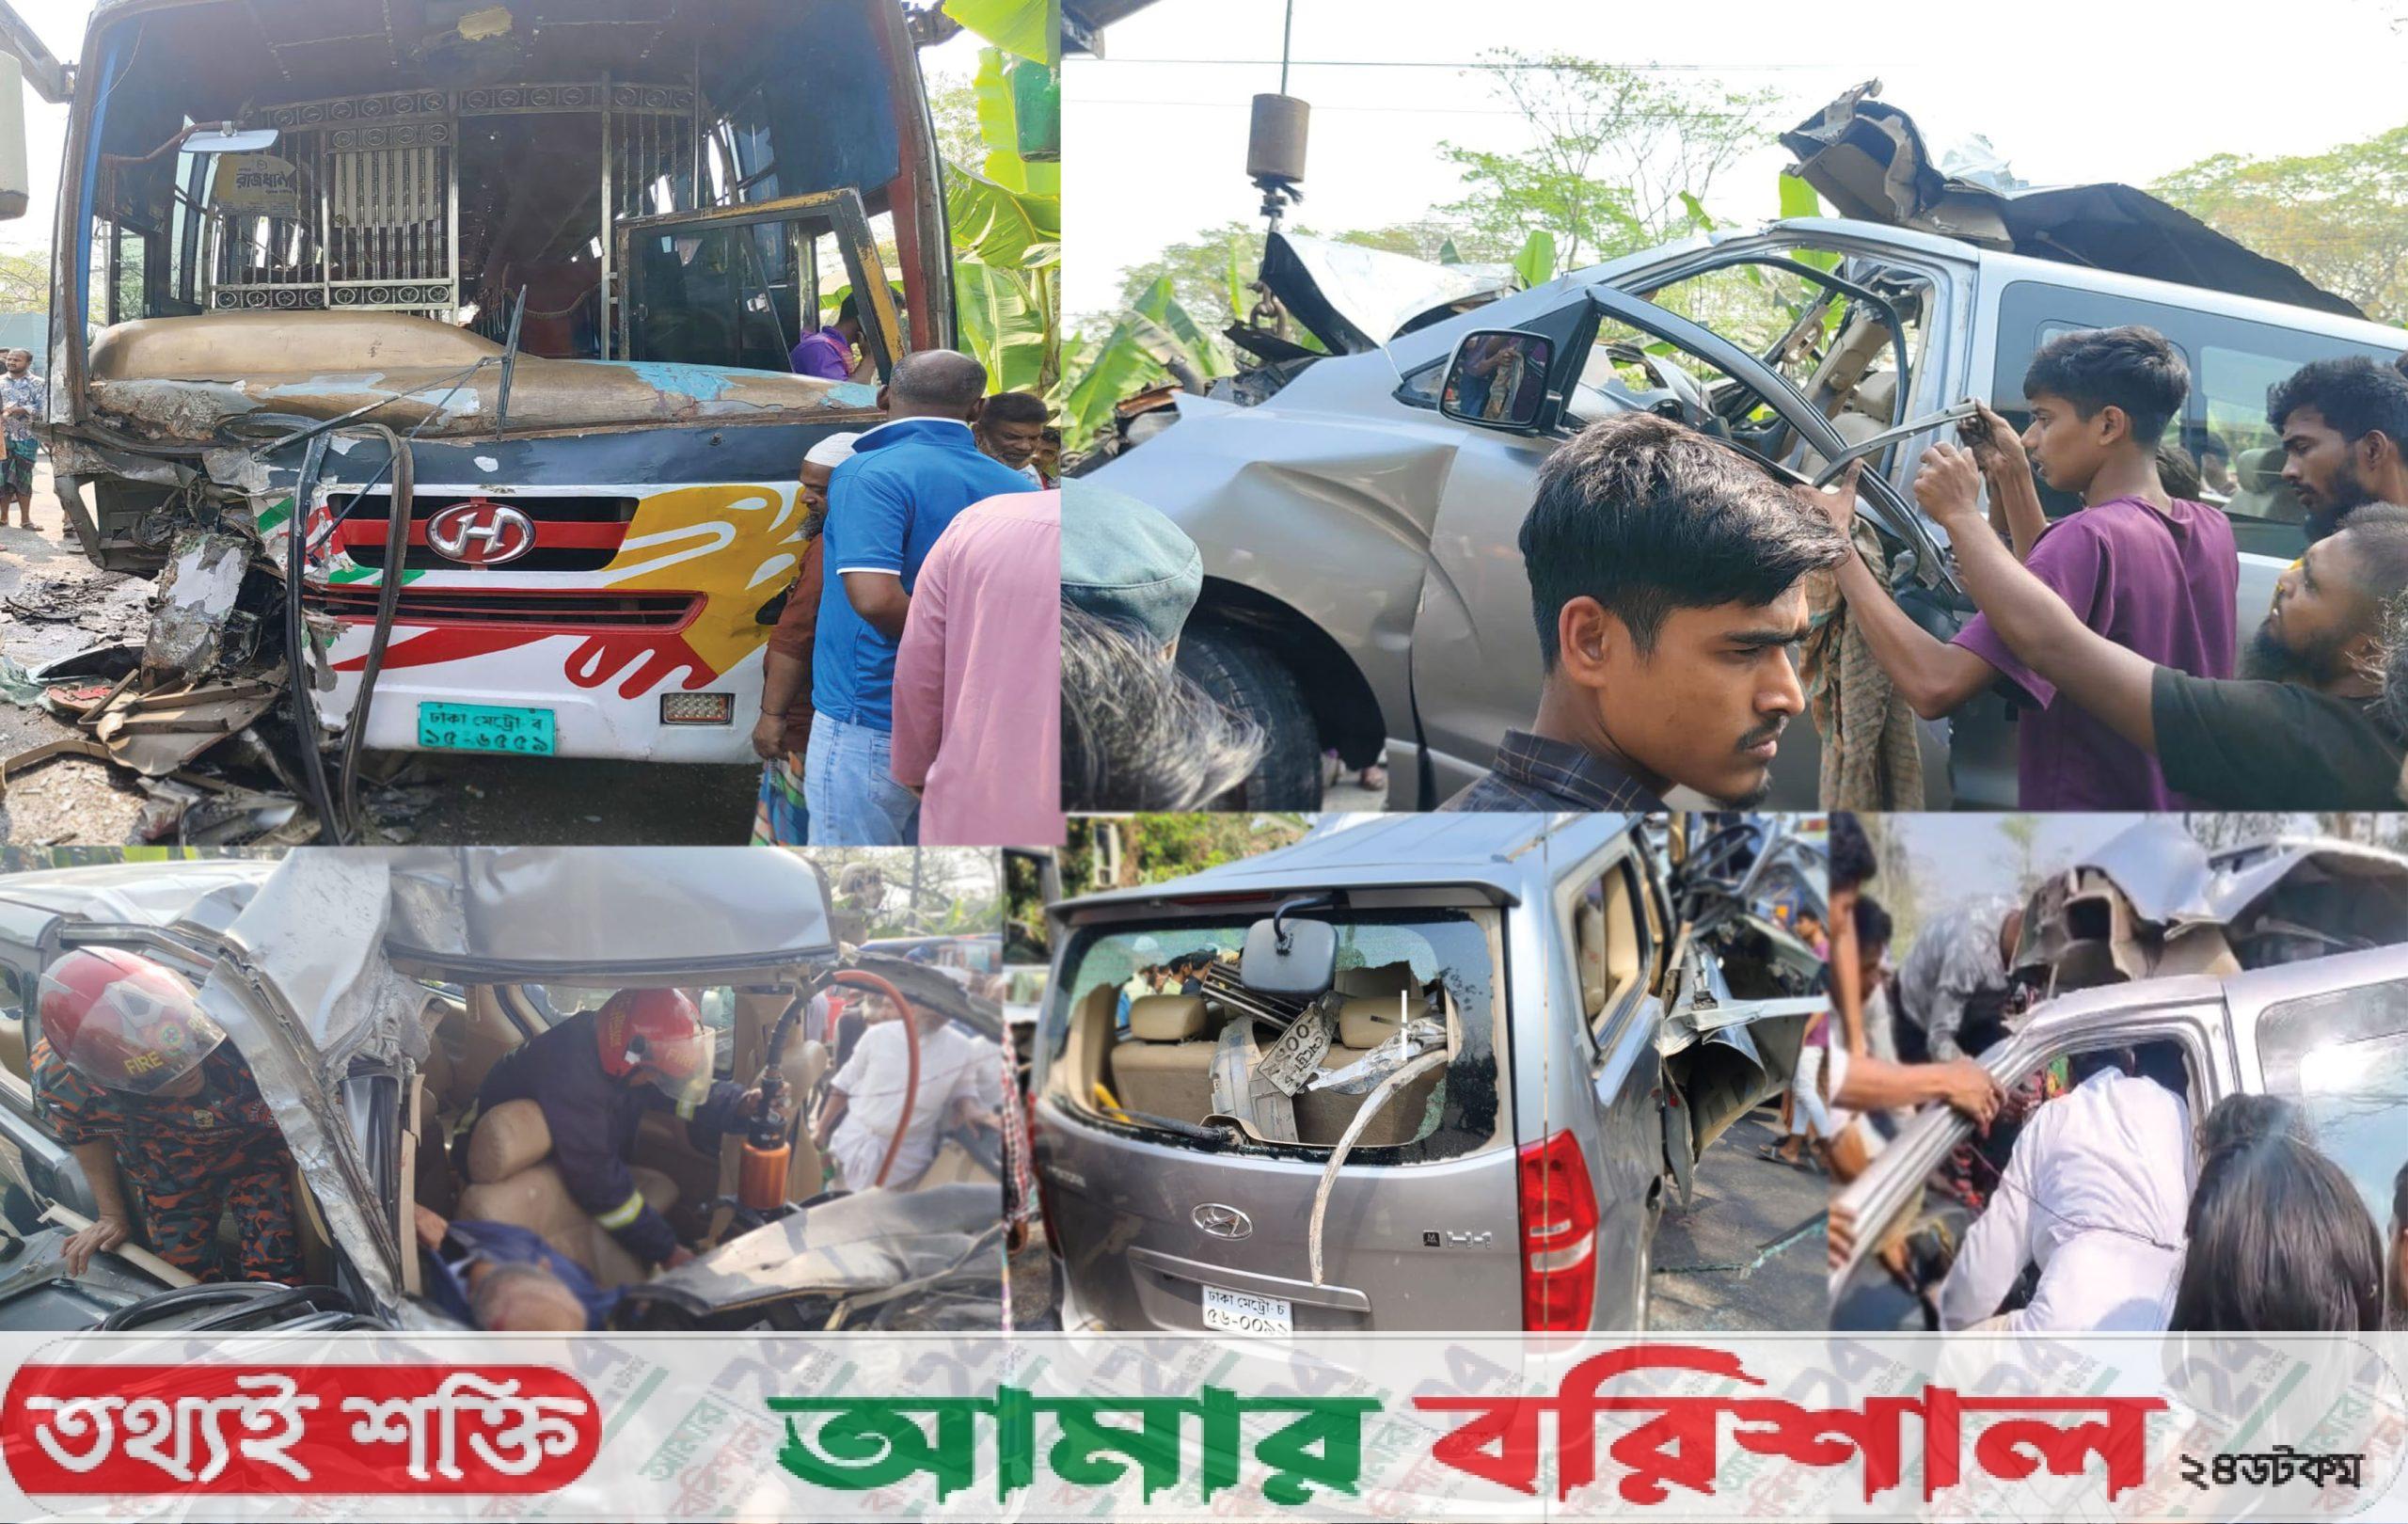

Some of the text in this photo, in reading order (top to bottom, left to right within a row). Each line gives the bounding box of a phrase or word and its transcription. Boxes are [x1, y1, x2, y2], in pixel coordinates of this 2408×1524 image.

[430, 712, 467, 724] ঢাকা
[123, 1051, 165, 1075] FIRE
[1208, 1291, 1234, 1307] ঢাকা
